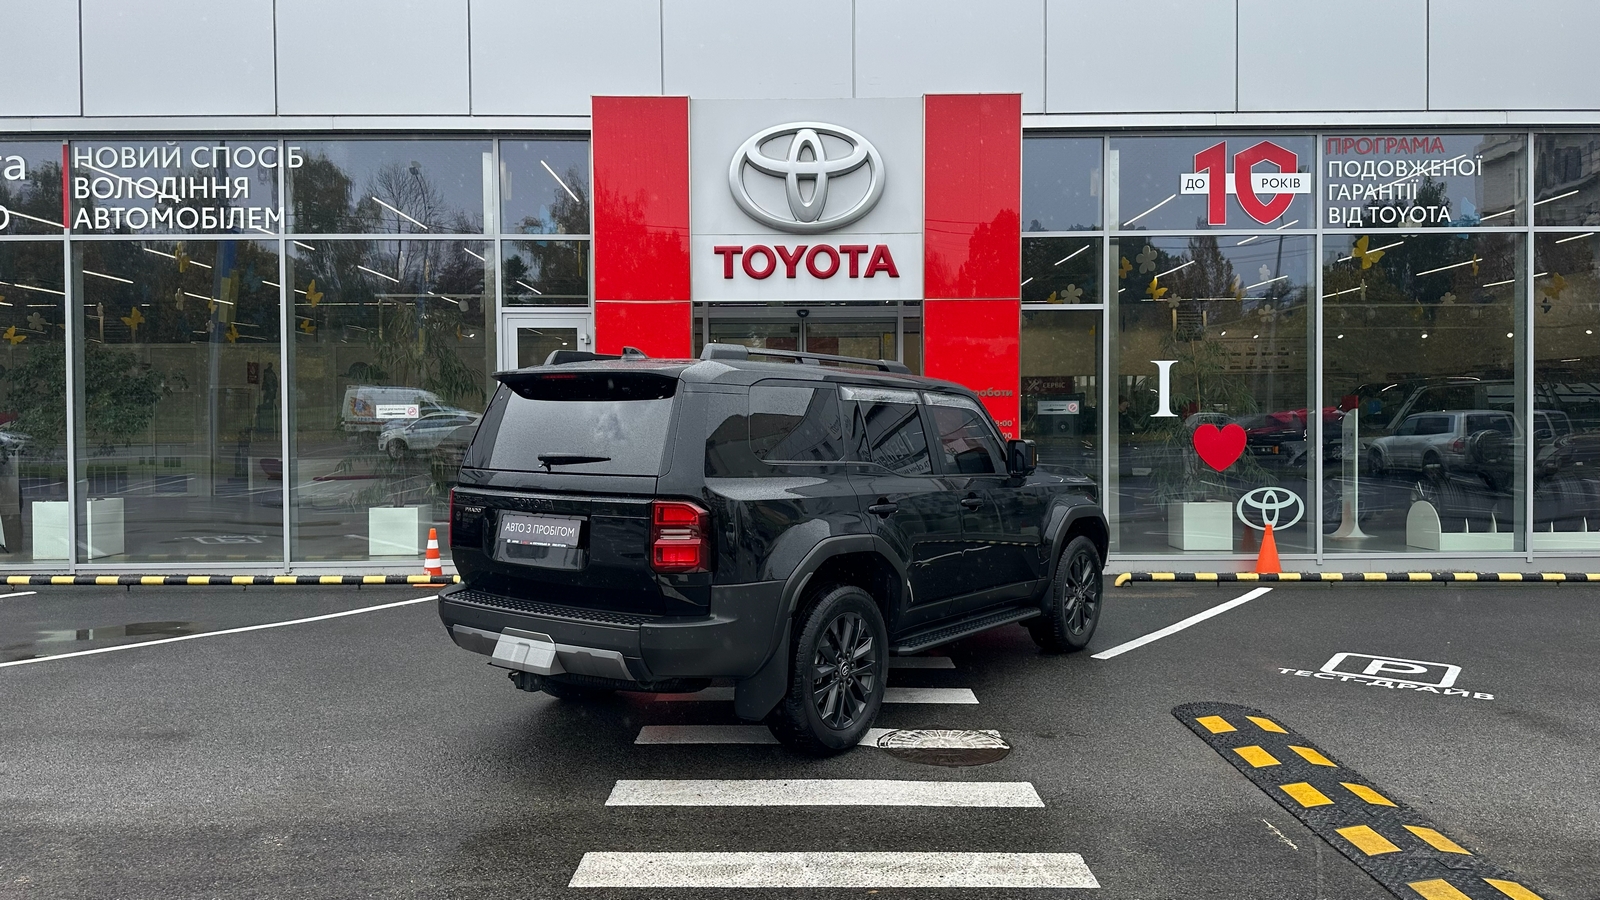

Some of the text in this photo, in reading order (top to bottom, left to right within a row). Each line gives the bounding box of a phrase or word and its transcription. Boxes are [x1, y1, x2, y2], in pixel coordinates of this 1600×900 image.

[74, 140, 304, 169] НОВИЙ СПОСІБ
[1326, 137, 1445, 154] ПРОГРАМА
[1328, 155, 1483, 179] ПОДОВЖЕНОЇ
[74, 176, 250, 204] ВОЛОДІННЯ
[1185, 140, 1301, 225] ДО 10 РОКІВ
[1328, 179, 1419, 200] ГАРАНТІЇ
[73, 207, 285, 230] АВТОМОБІЛЕМ
[1328, 206, 1452, 227] ВІД TOYOTA
[713, 244, 900, 280] TOYOTA
[504, 522, 525, 533] АВТО
[532, 524, 575, 538] ПРОБІГОМ
[1363, 659, 1428, 676] P
[1278, 667, 1495, 700] ТЕСТ-ДРАЙВ
